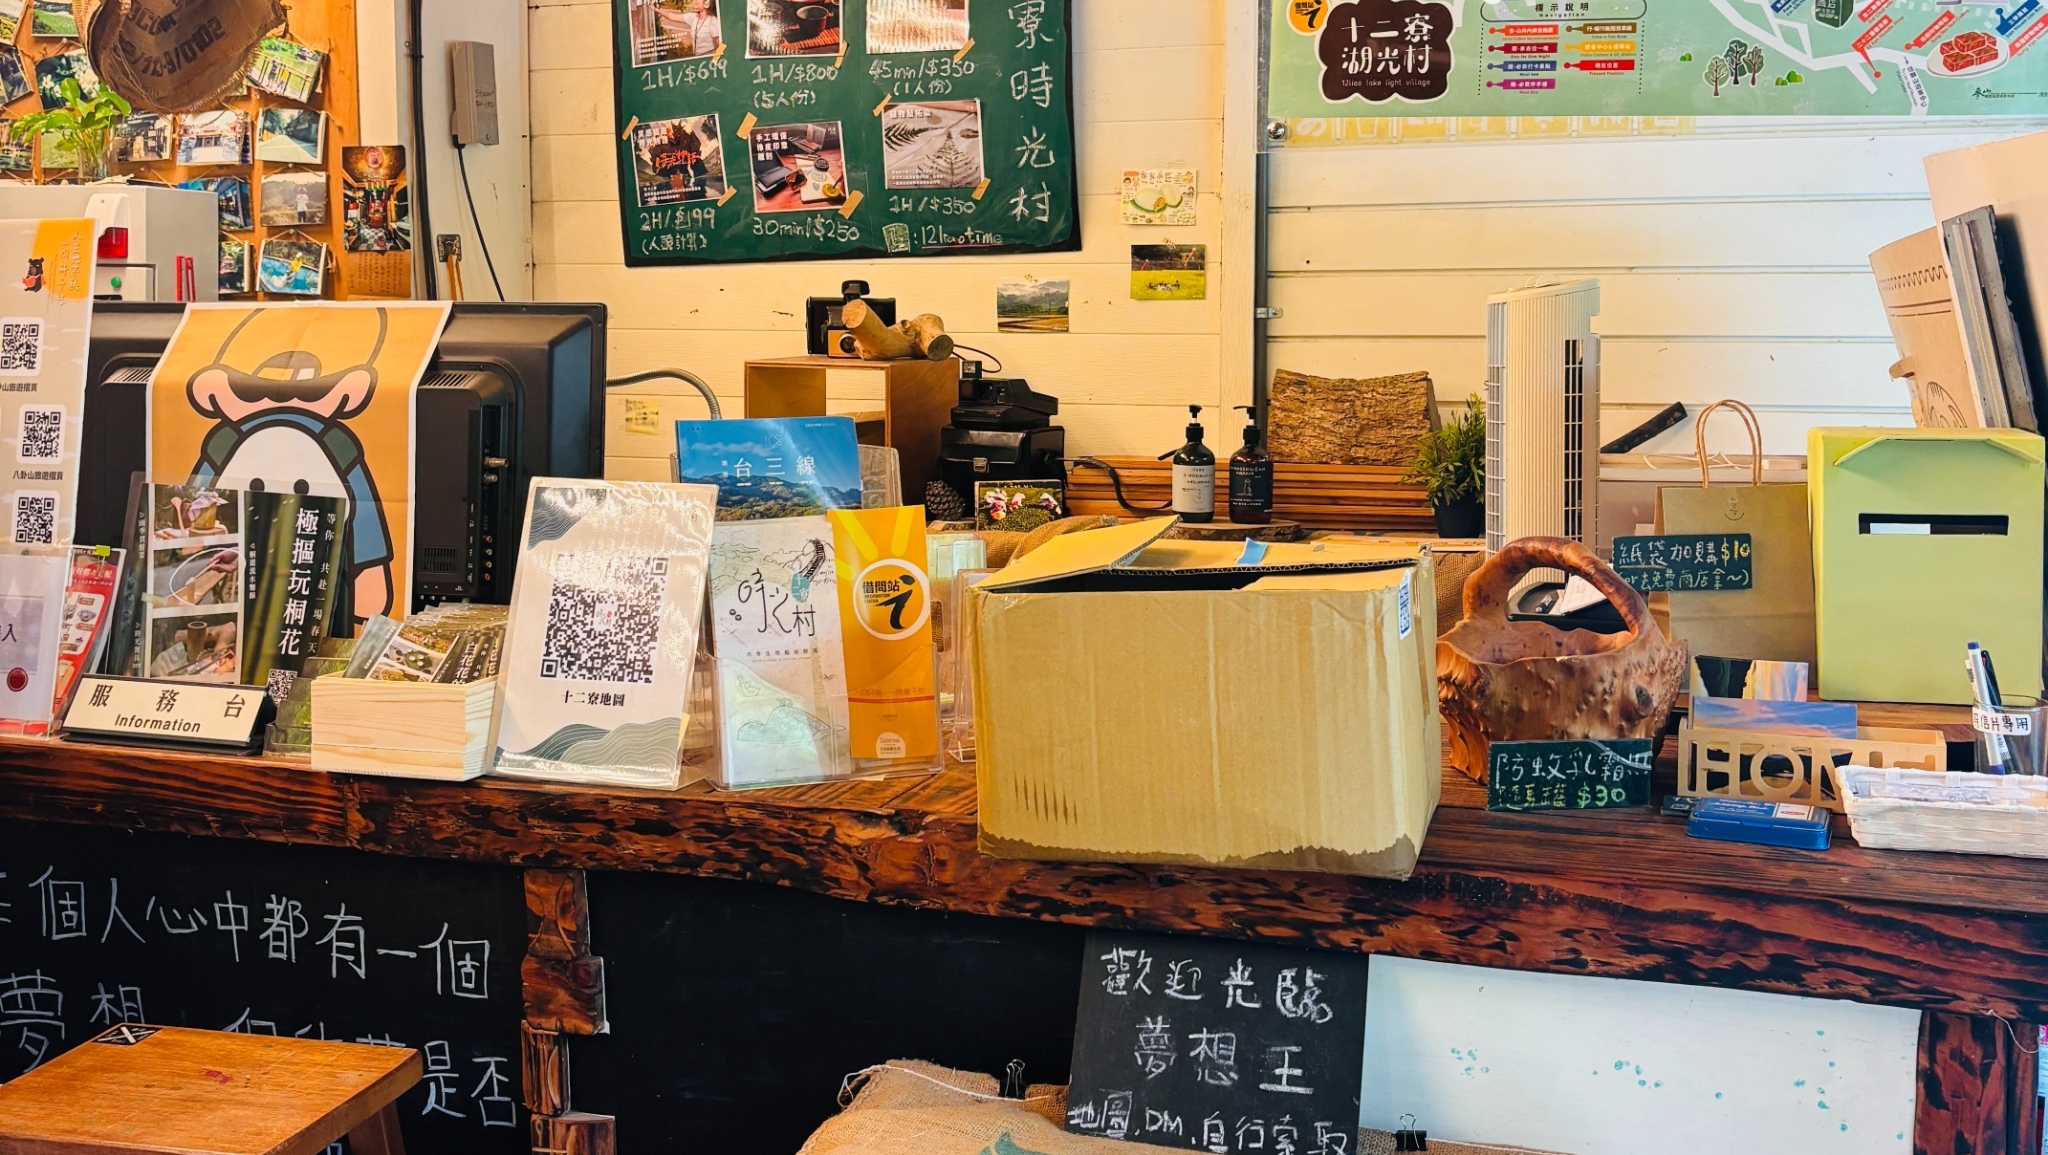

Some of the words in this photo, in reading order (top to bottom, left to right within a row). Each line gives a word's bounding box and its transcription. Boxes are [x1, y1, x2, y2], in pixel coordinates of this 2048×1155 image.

[1535, 3, 1590, 12] 標示說明
[1341, 13, 1433, 43] 十二寮
[869, 58, 975, 79] 45min/$350
[1341, 44, 1433, 74] 湖光村
[641, 58, 728, 90] 1H/$699
[752, 63, 839, 84] 1H/$800
[753, 89, 816, 108] (5人份)
[893, 79, 953, 96] (1人份)
[756, 131, 787, 143] 手工環保
[733, 454, 816, 478] 台三線
[1619, 537, 1750, 567] 紙袋加購$10
[278, 507, 320, 656] 極摳玩桐花
[862, 580, 900, 594] 借問站
[88, 683, 246, 719] 服務台
[561, 690, 626, 707] 十二寮地圖
[114, 713, 201, 733] Information
[1576, 781, 1626, 809] $30
[1101, 944, 1334, 1023] 歡迎光臨
[1134, 1015, 1314, 1095] 夢想王
